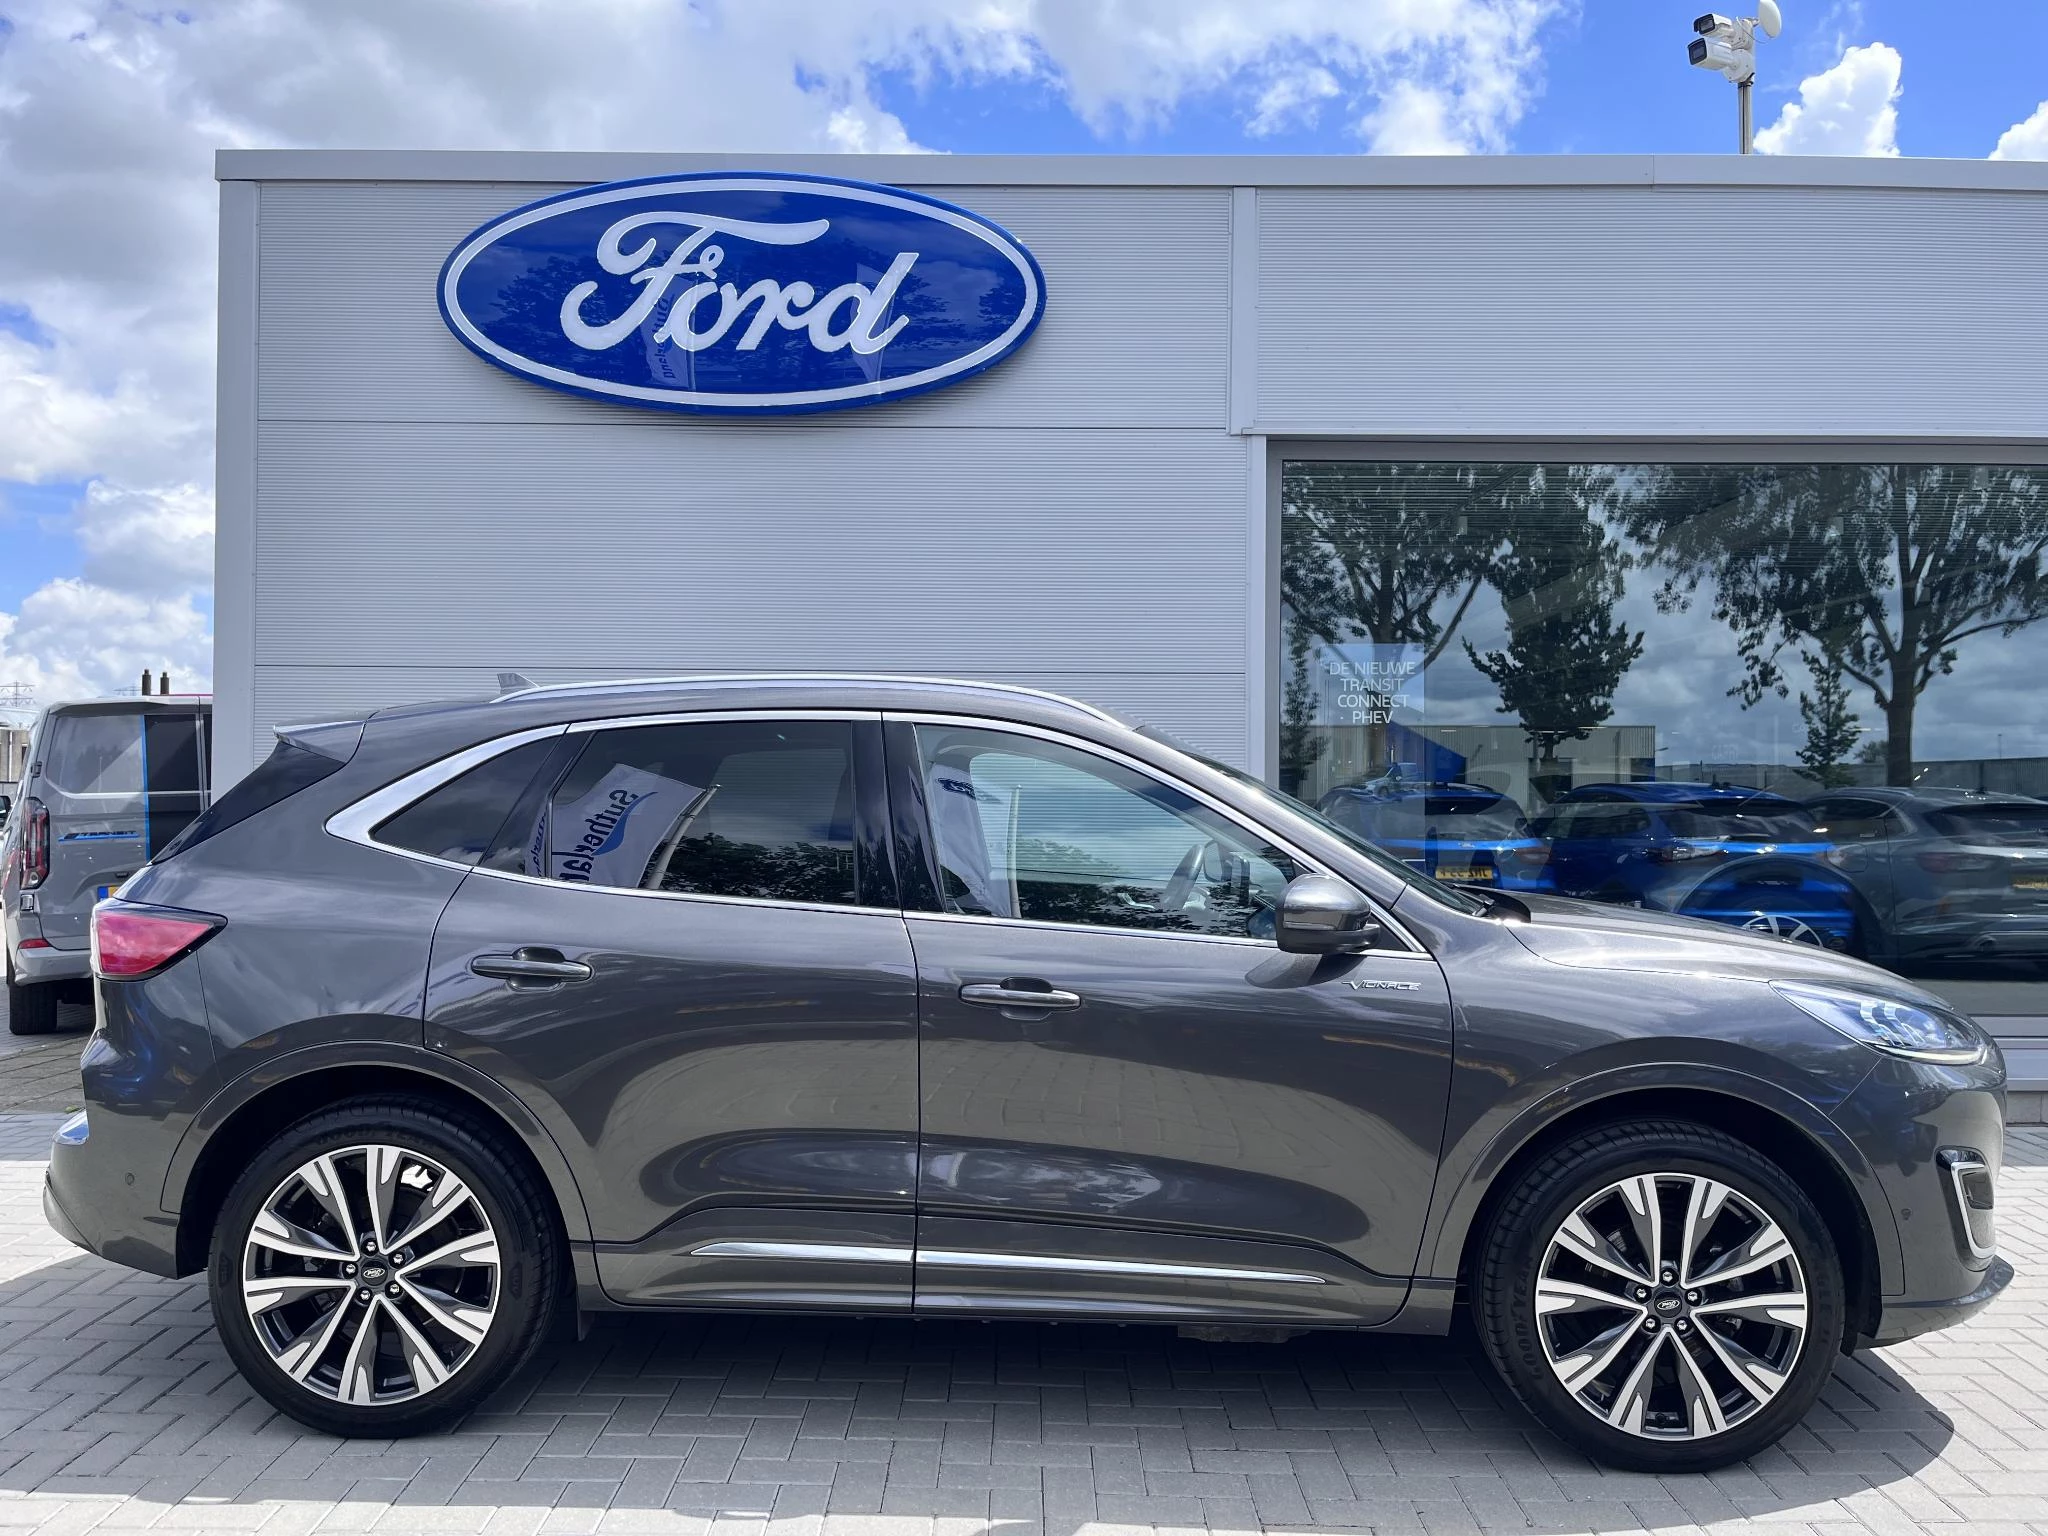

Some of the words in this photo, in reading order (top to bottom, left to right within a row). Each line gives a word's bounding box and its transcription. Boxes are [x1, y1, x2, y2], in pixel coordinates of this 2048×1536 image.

[560, 211, 919, 354] Ford
[1329, 662, 1350, 675] DE
[1355, 661, 1416, 675] NIEUWE
[1340, 678, 1404, 691] TRANSIT
[1337, 694, 1410, 708] CONNECT
[1352, 711, 1393, 724] PHEV
